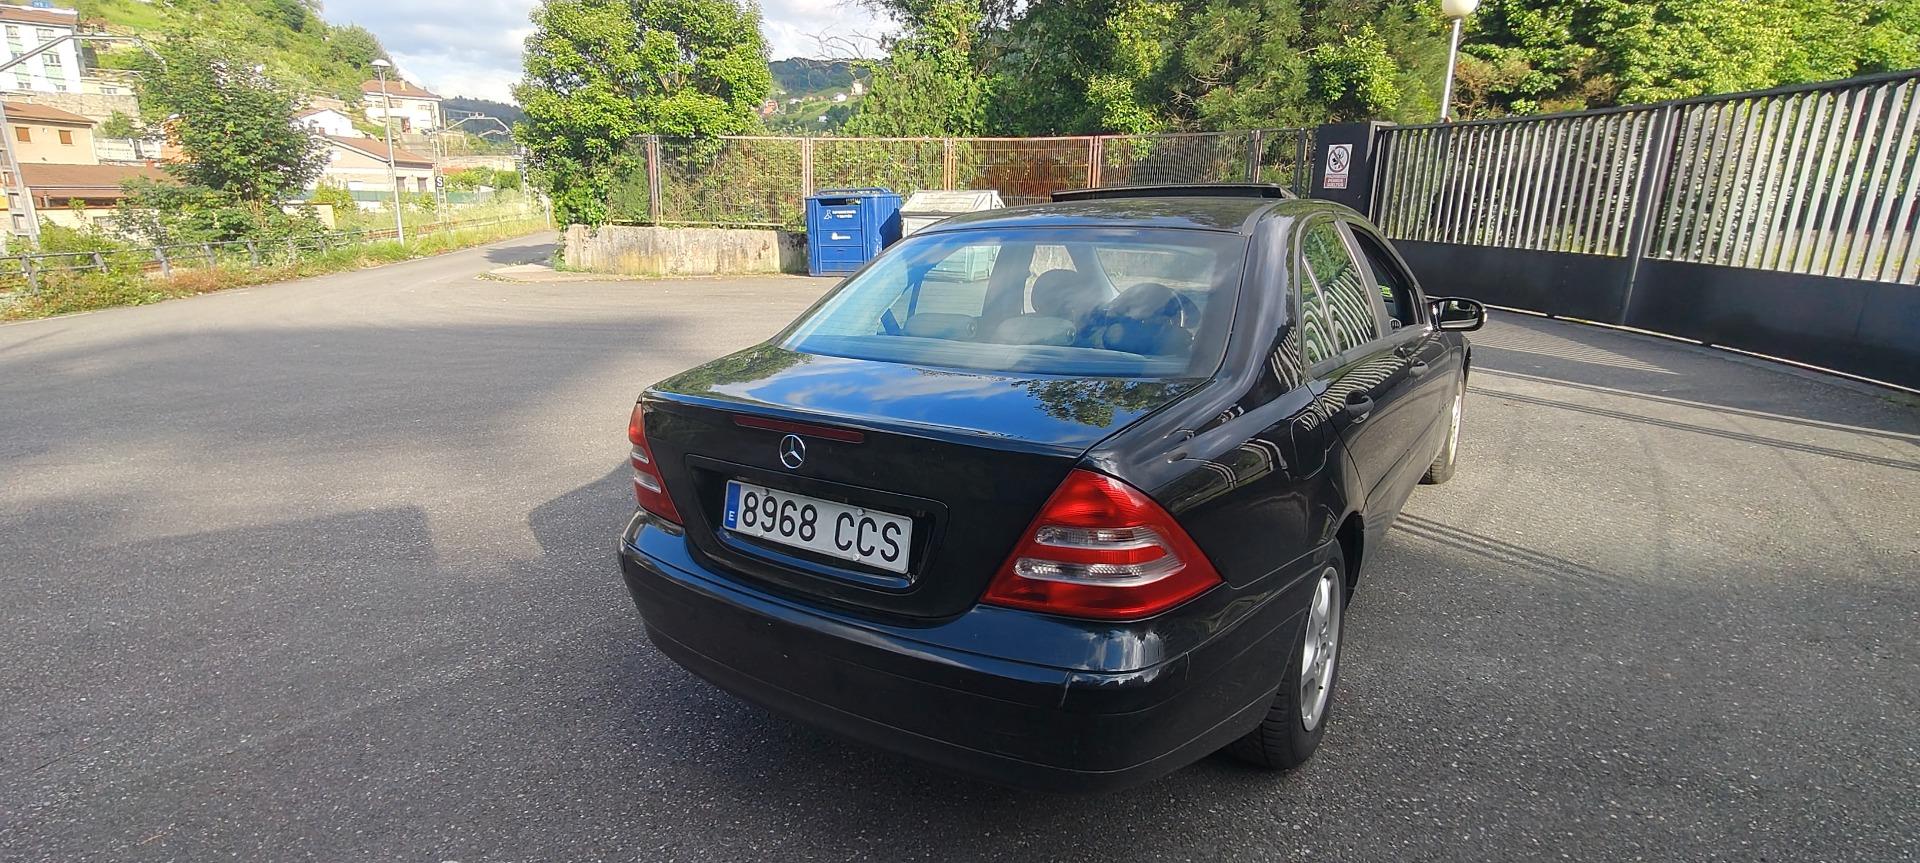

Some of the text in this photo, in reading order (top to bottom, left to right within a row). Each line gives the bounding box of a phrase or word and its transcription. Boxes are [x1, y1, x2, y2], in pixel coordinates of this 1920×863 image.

[436, 176, 443, 187] S
[728, 510, 735, 521] E
[742, 491, 902, 562] 8968 CCS
